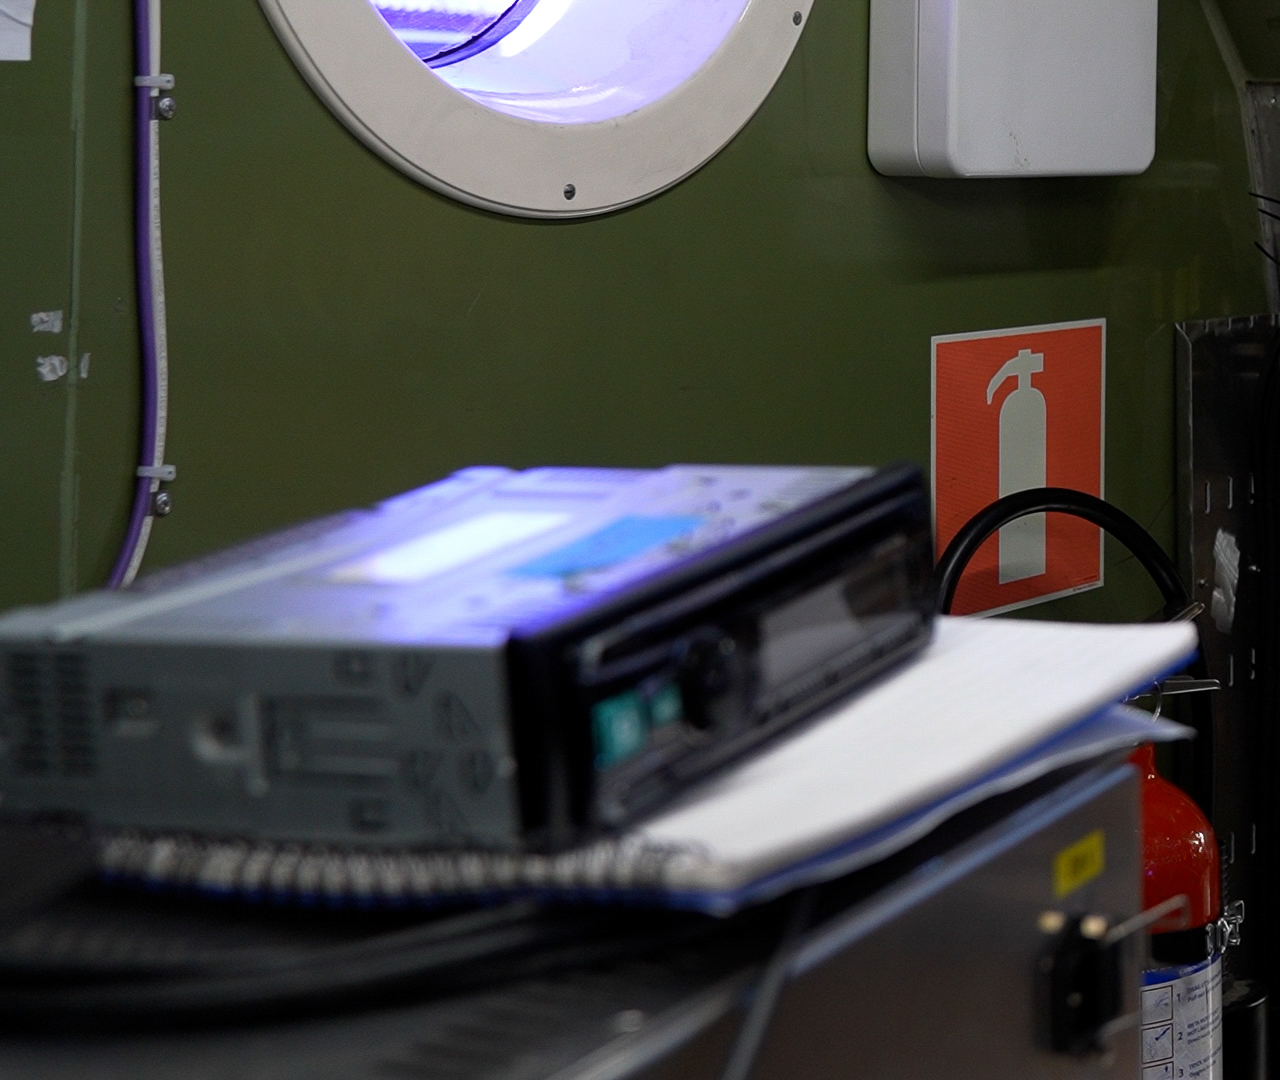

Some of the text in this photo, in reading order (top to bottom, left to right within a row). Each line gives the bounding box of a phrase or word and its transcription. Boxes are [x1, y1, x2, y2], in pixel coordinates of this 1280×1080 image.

[1176, 993, 1182, 1003] 1
[1178, 1031, 1183, 1041] 2
[1178, 1068, 1184, 1078] 3
